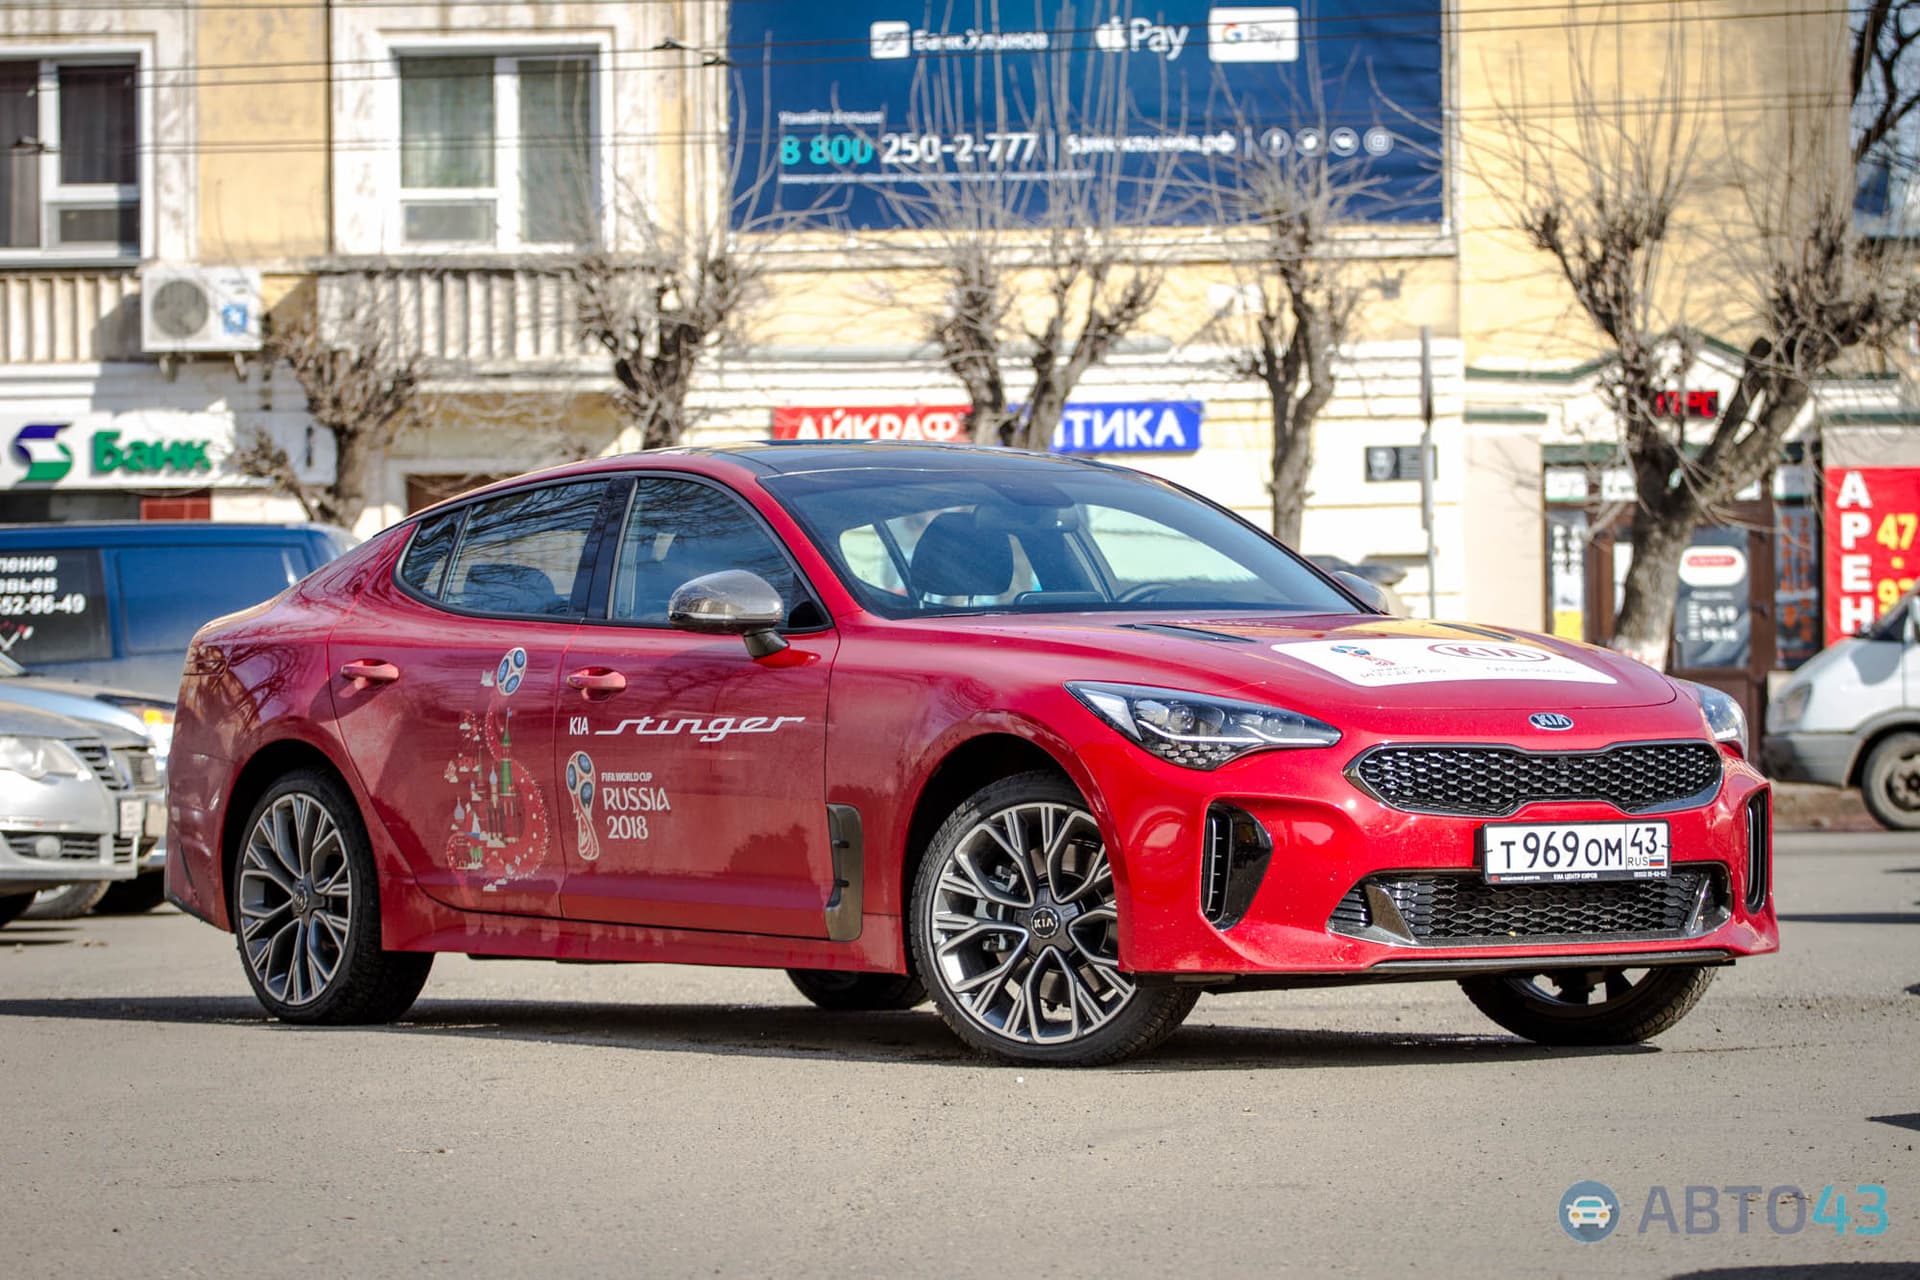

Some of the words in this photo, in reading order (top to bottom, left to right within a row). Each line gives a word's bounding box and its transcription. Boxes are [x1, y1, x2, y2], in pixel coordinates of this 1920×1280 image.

[1130, 17, 1189, 61] Pay
[780, 135, 800, 165] 8
[810, 134, 872, 164] 800
[881, 132, 1038, 164] 250-2-777
[796, 409, 966, 440] АЙКРАФ
[93, 430, 212, 473] Банк
[1876, 513, 1918, 550] 47
[569, 717, 589, 735] KIA
[595, 716, 806, 742] stinger
[1534, 714, 1570, 726] KIA
[602, 787, 671, 811] RUSSIA
[606, 815, 649, 840] 2018
[1630, 827, 1658, 855] 43
[1627, 857, 1649, 867] RUS
[1034, 917, 1054, 928] KIA
